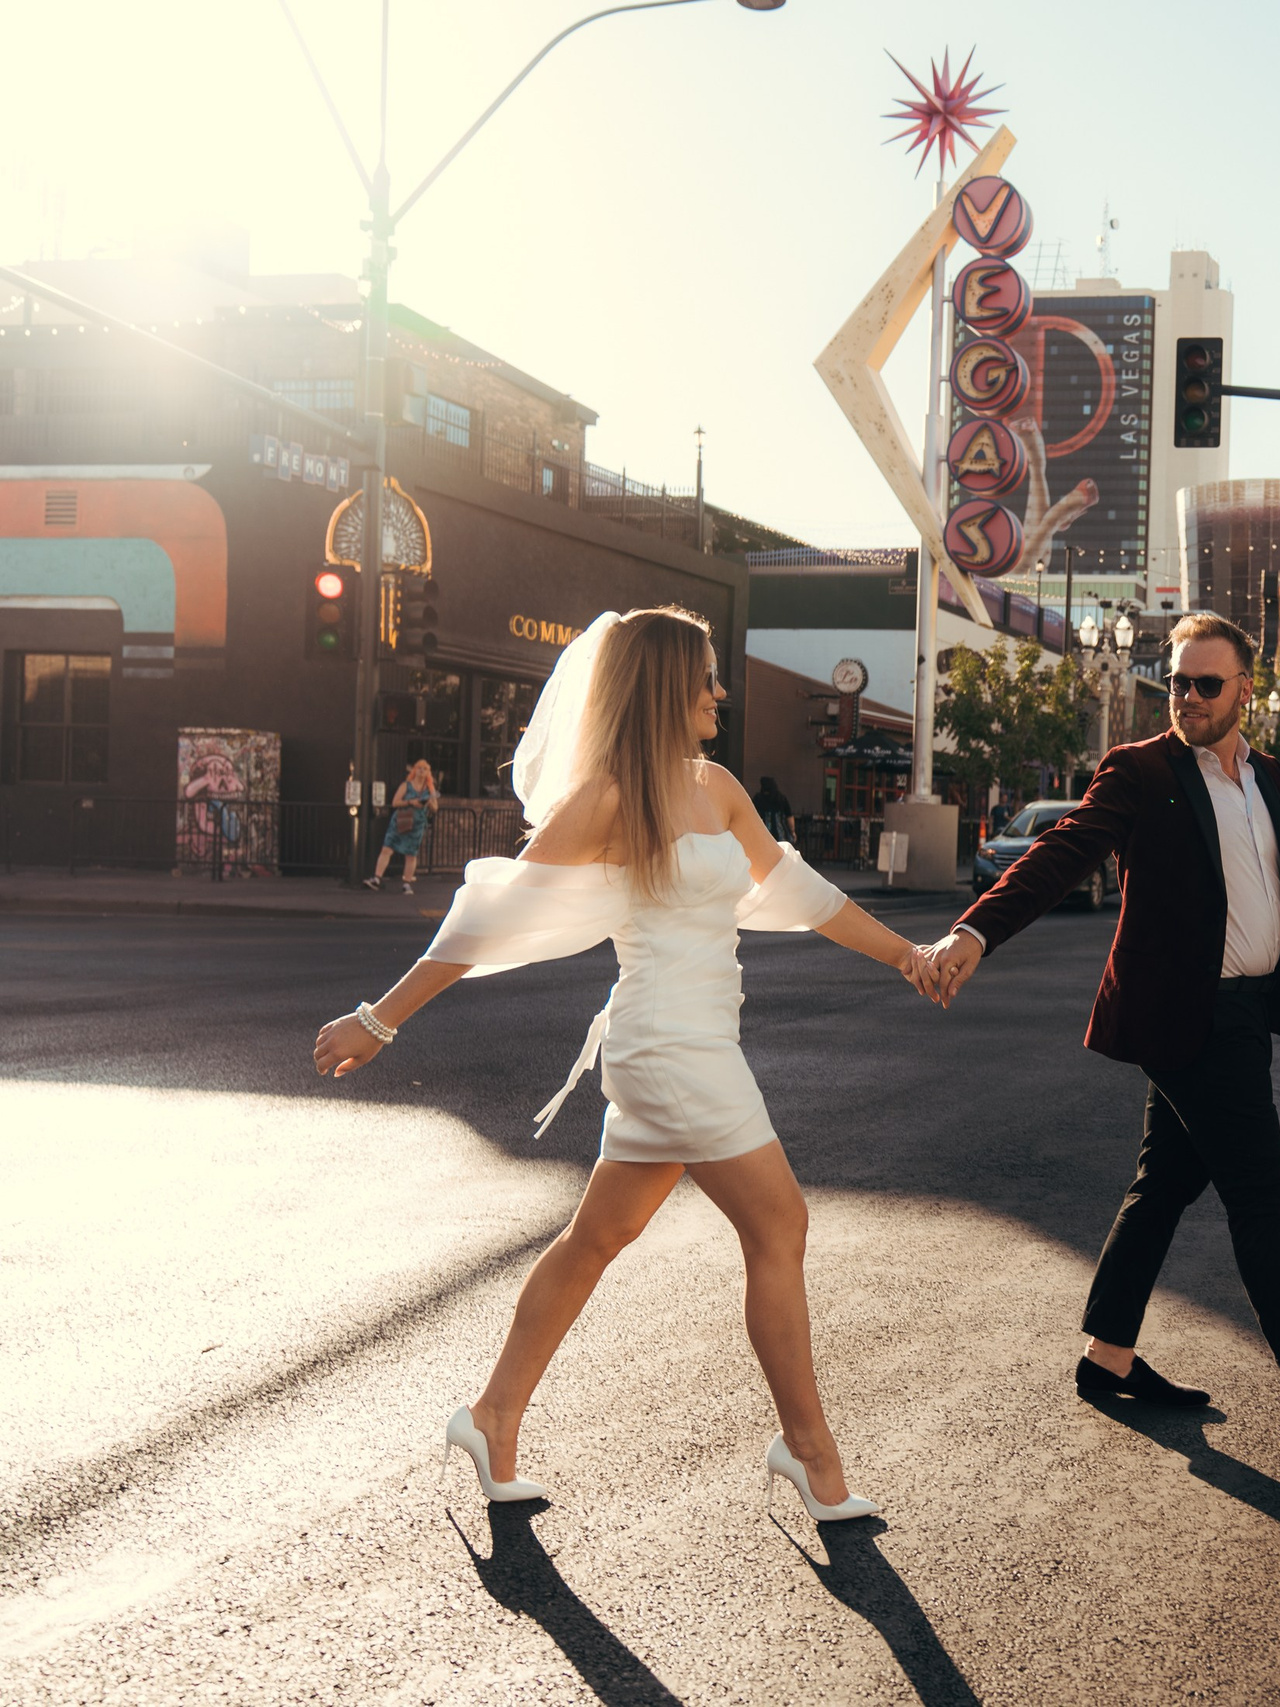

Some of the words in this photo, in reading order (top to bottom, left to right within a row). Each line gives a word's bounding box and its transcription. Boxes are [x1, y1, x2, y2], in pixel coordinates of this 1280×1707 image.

[951, 183, 1018, 567] VEGAS
[1121, 314, 1141, 397] VEGAS
[266, 446, 348, 485] FREMONT
[1120, 414, 1138, 460] LAS
